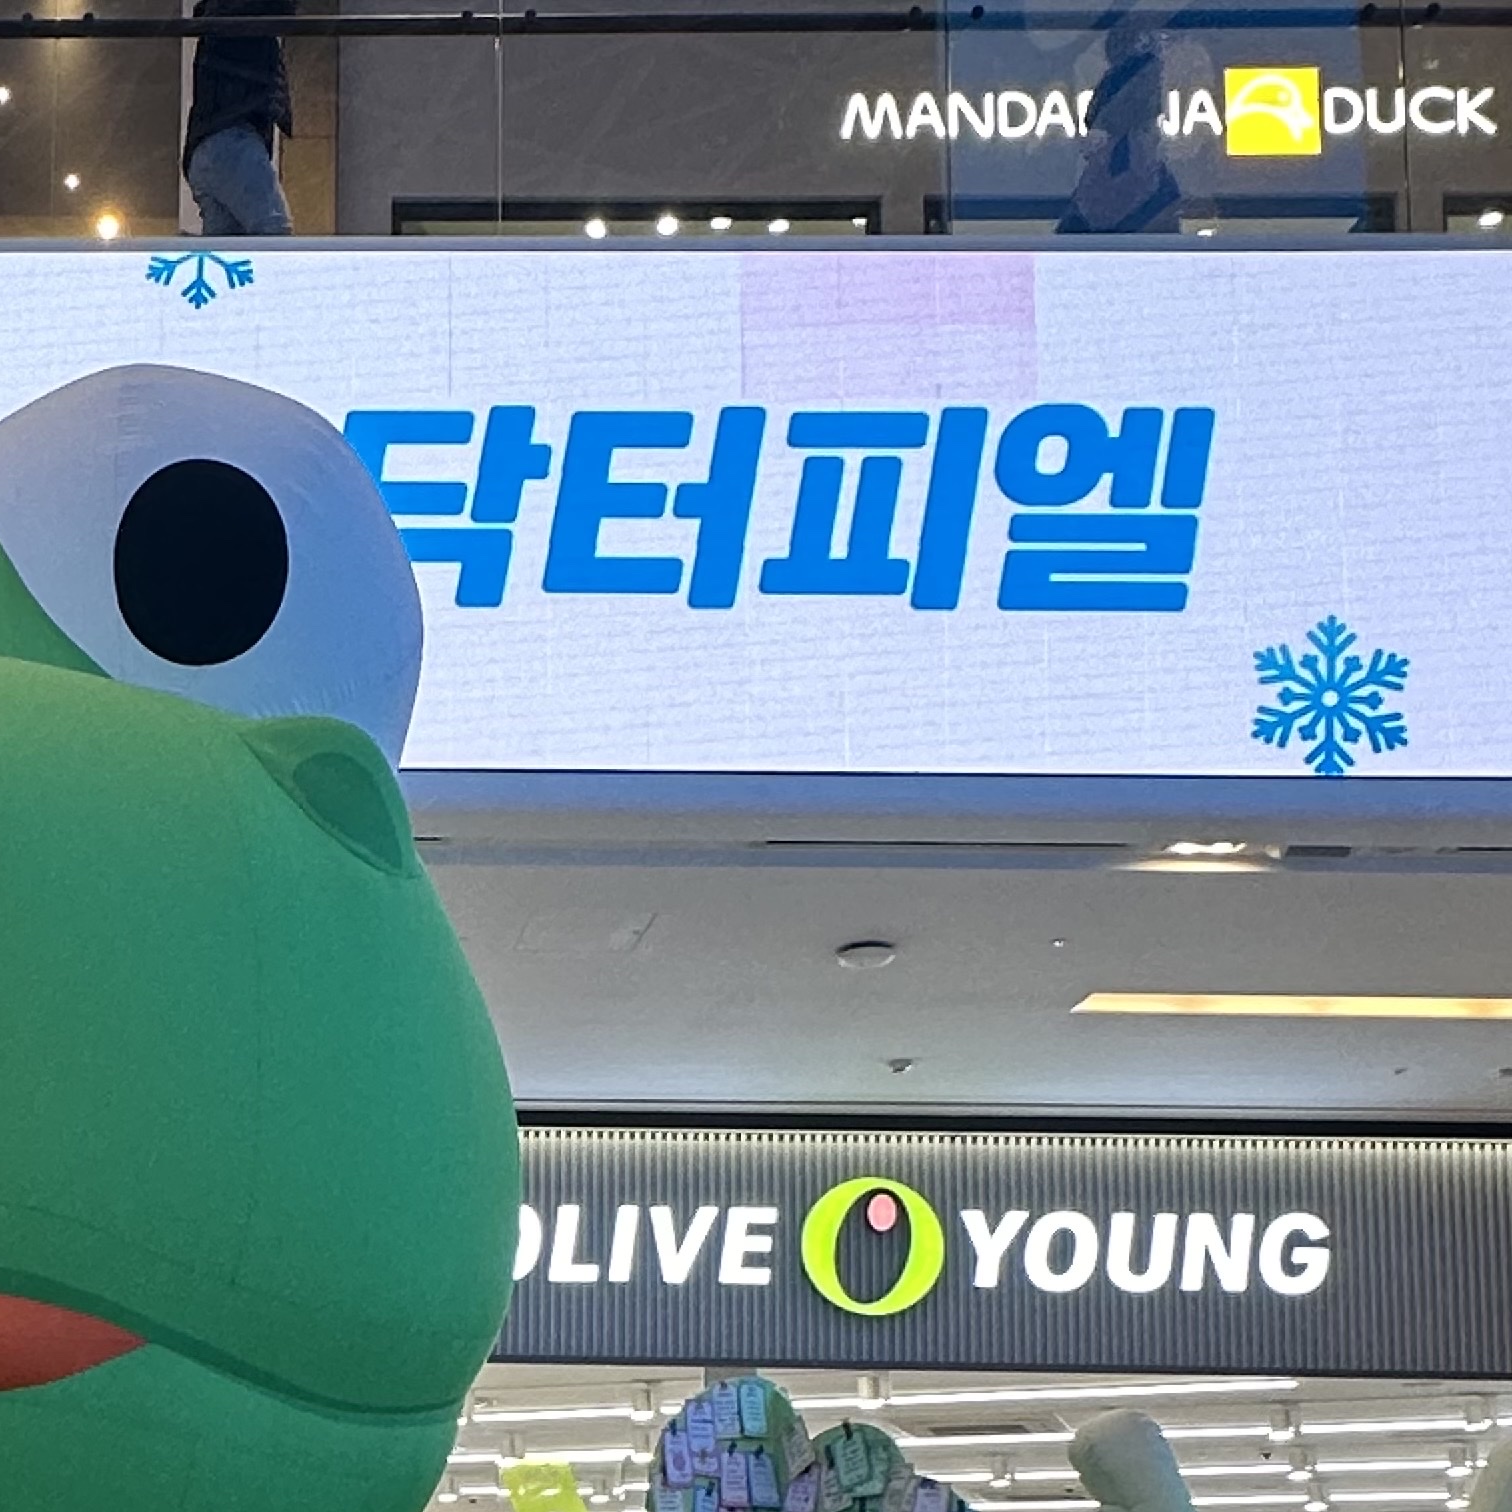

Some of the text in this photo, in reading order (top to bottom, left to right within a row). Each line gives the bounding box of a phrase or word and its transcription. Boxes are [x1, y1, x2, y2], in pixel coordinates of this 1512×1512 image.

[1322, 86, 1498, 136] DUCK
[343, 403, 1216, 612] 닥터피엘
[960, 1208, 1330, 1296] YOUNG
